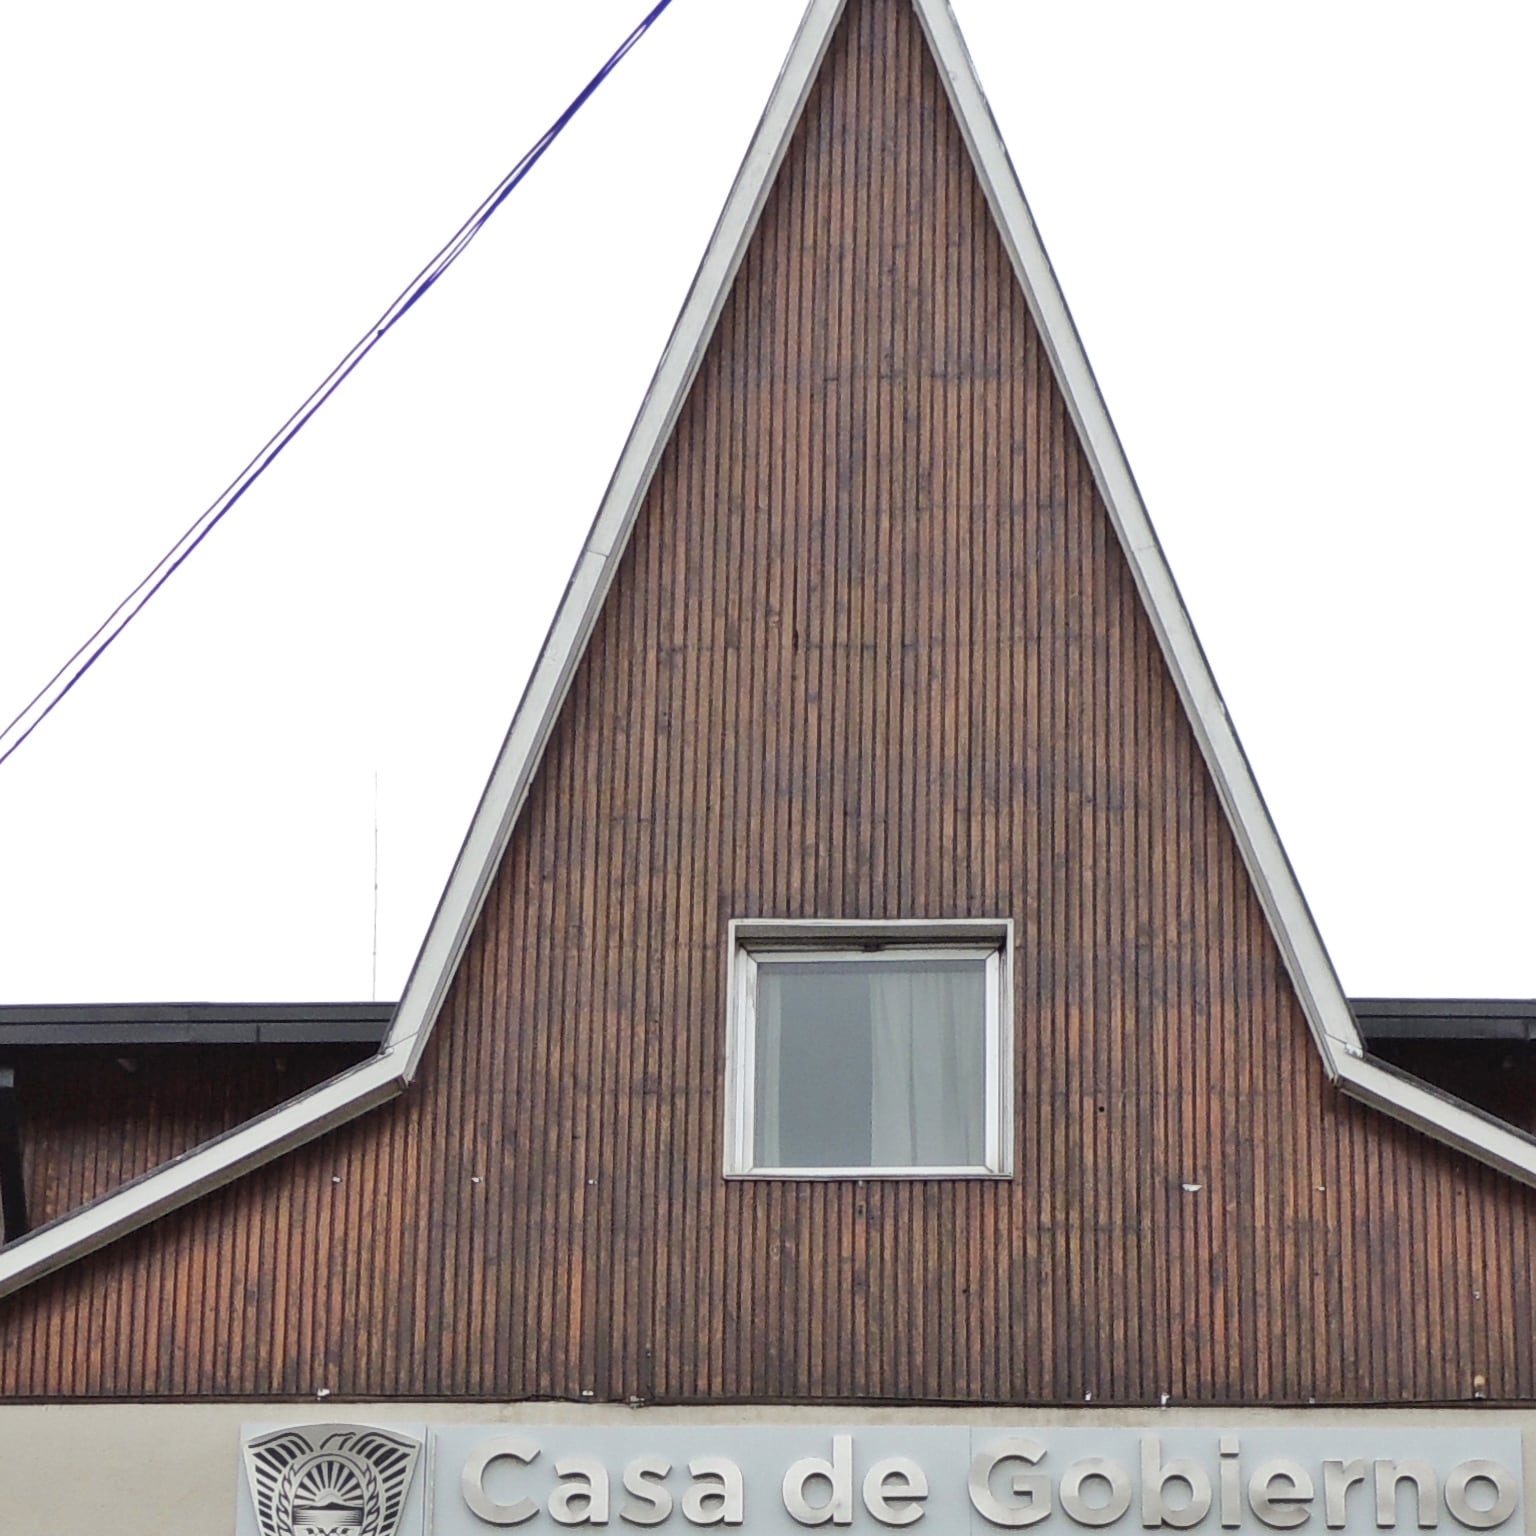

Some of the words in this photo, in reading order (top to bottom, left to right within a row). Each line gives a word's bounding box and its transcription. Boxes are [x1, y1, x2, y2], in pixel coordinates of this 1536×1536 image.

[462, 1435, 745, 1526] Casa
[783, 1435, 929, 1526] de
[968, 1435, 1519, 1529] Gobierno
